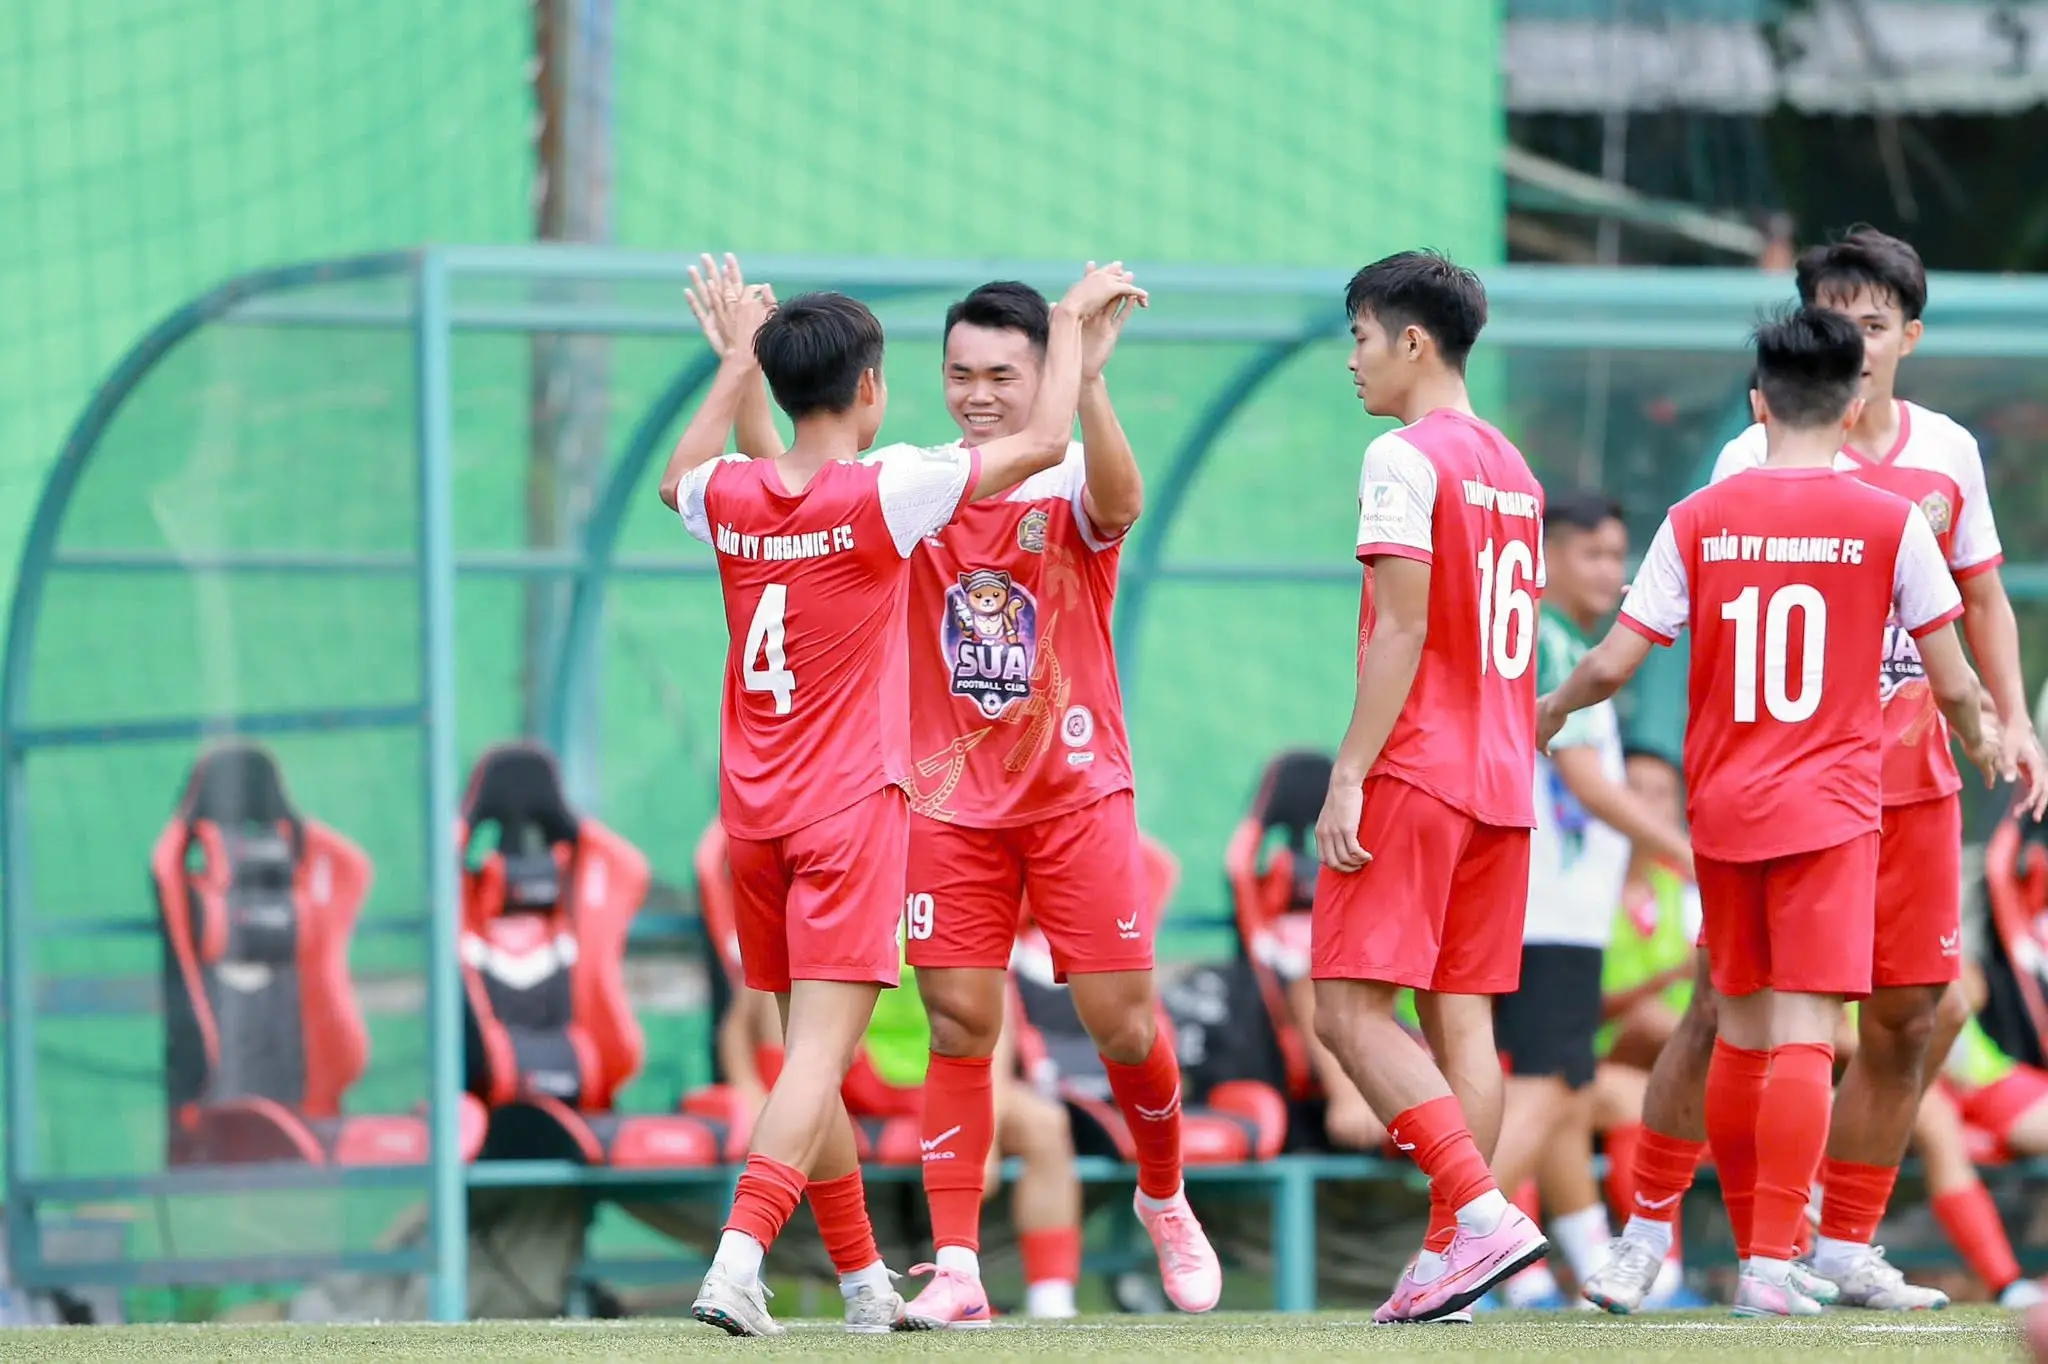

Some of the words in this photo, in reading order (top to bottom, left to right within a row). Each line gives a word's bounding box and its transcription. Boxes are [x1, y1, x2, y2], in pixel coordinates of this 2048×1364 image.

[742, 533, 760, 560] VY
[763, 530, 830, 561] ORGANIC
[832, 524, 855, 553] FC
[1741, 535, 1764, 562] VY
[1765, 537, 1840, 563] ORGANIC
[1841, 538, 1865, 565] FC
[1477, 537, 1534, 681] 16
[743, 583, 797, 715] 4
[1721, 583, 1828, 723] 10
[956, 680, 1002, 691] FOOTBALL
[1004, 682, 1028, 693] CLUB
[906, 892, 935, 940] 19
